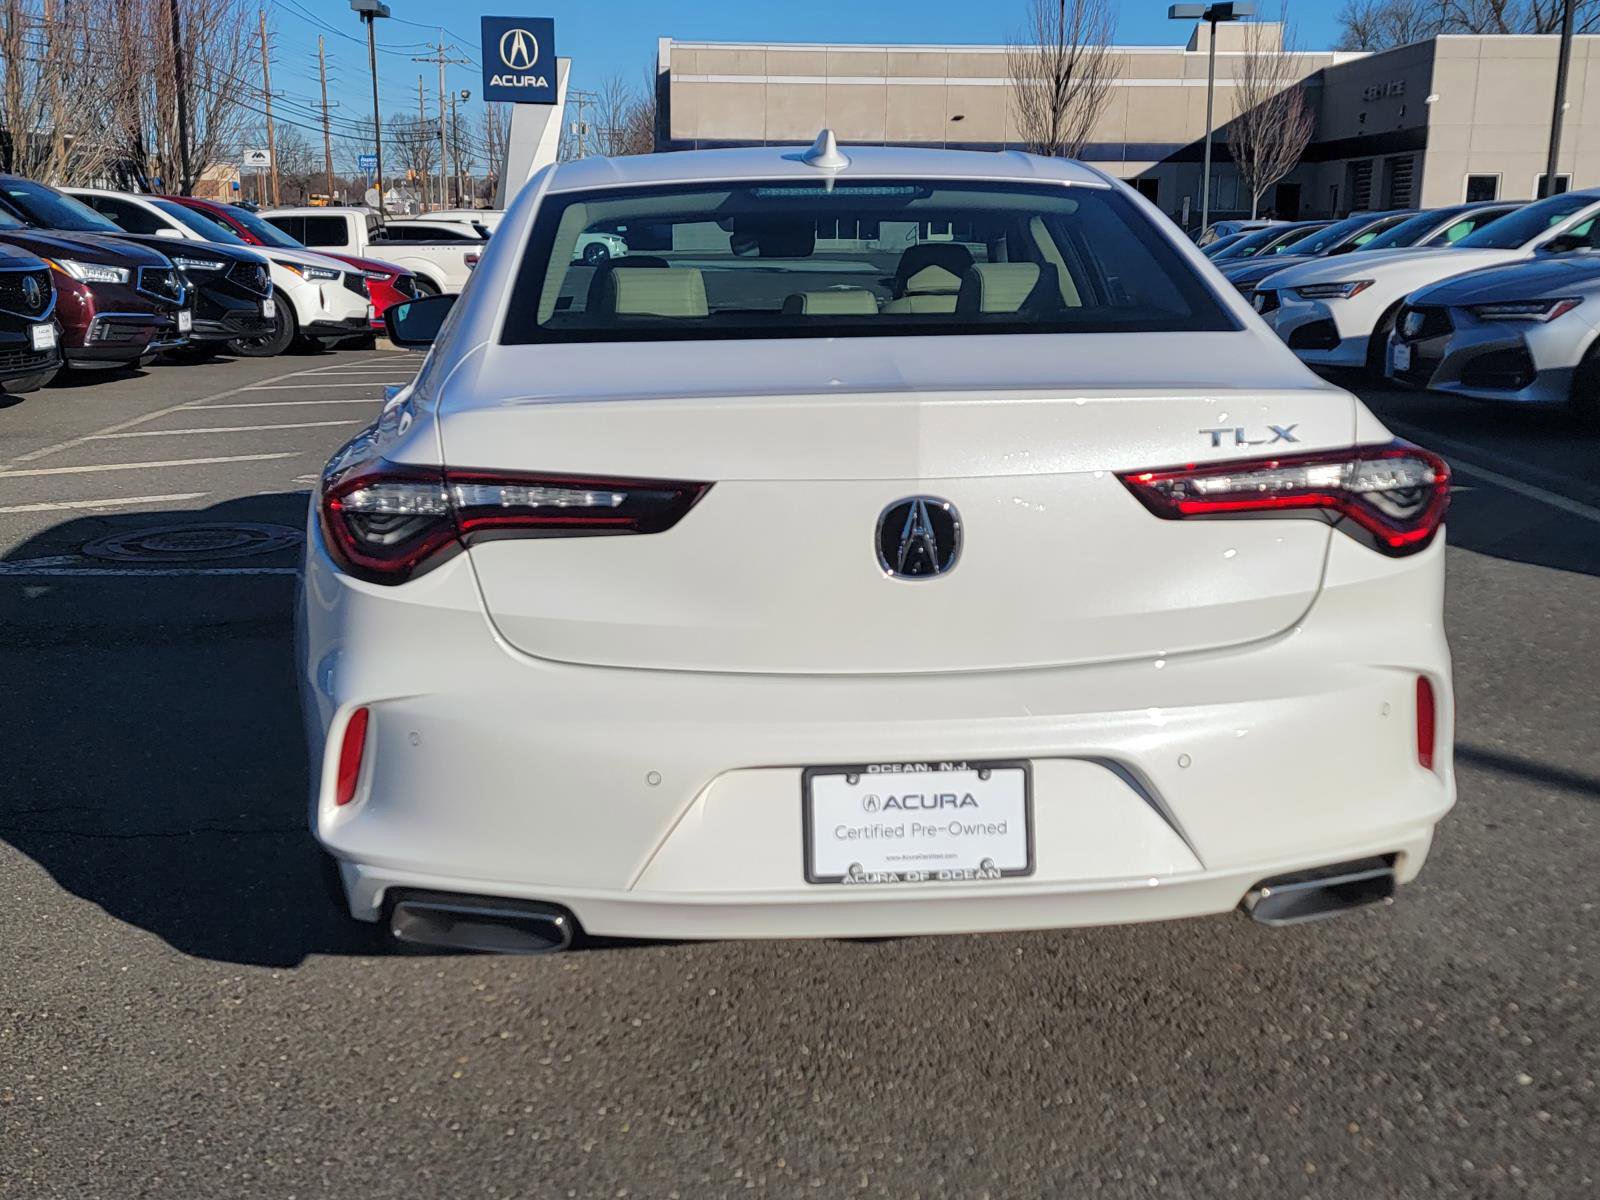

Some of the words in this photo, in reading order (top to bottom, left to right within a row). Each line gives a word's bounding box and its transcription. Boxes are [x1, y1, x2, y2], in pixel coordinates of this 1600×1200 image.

[490, 74, 549, 88] ACURA
[1199, 423, 1301, 447] TLX
[882, 793, 980, 811] ACURA
[834, 824, 905, 841] Certified
[911, 820, 1008, 838] Pre-Owned
[842, 870, 900, 884] ACURA
[906, 870, 929, 881] OF
[938, 867, 1001, 880] OCEAN
